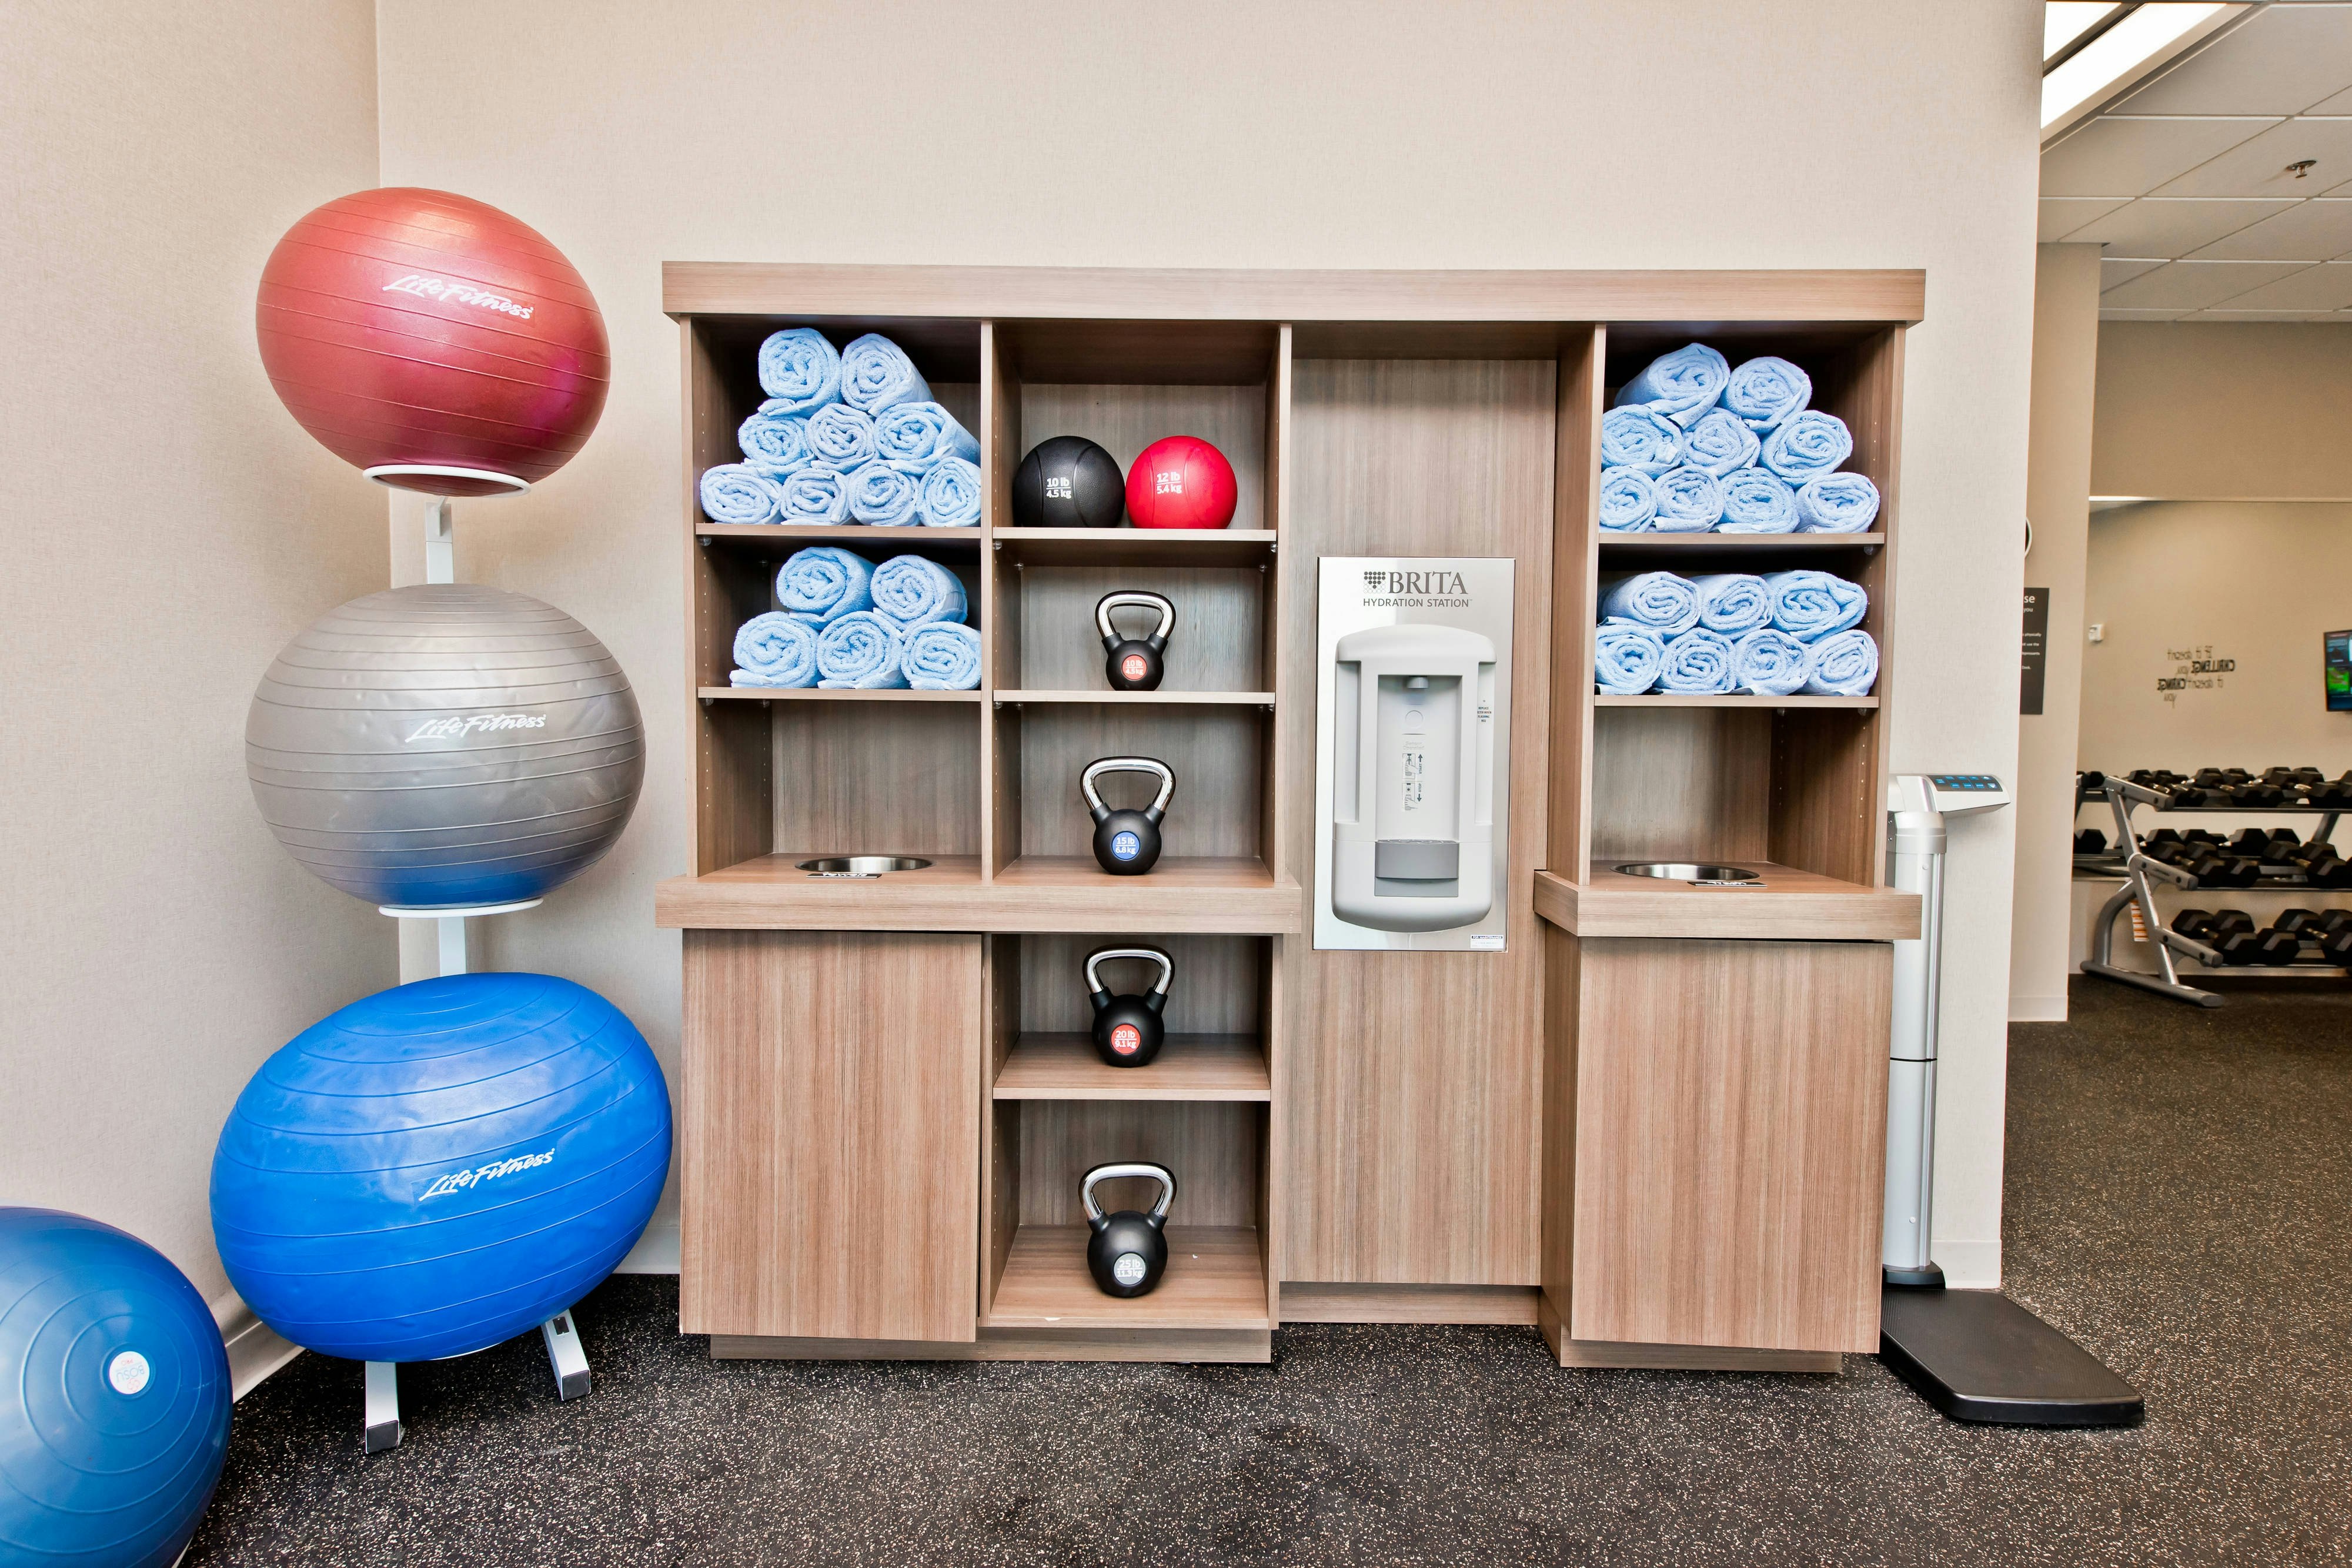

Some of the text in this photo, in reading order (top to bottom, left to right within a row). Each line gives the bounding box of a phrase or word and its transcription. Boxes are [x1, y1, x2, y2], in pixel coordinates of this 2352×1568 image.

[1157, 471, 1181, 483] 12 lb
[1047, 477, 1070, 487] 10 lb
[1157, 483, 1182, 494] 5.4 kg
[1046, 489, 1072, 500] 4.5 kg
[1388, 571, 1469, 594] BRITA
[1363, 598, 1470, 607] HYDRATION STATION
[1117, 837, 1127, 845] 15
[1127, 847, 1137, 855] kg
[1115, 1030, 1135, 1038] 20 lb
[1127, 1040, 1137, 1049] kg
[1119, 1259, 1141, 1268] 25 lb
[1132, 1270, 1143, 1278] kg
[116, 1365, 145, 1383] BOSU
